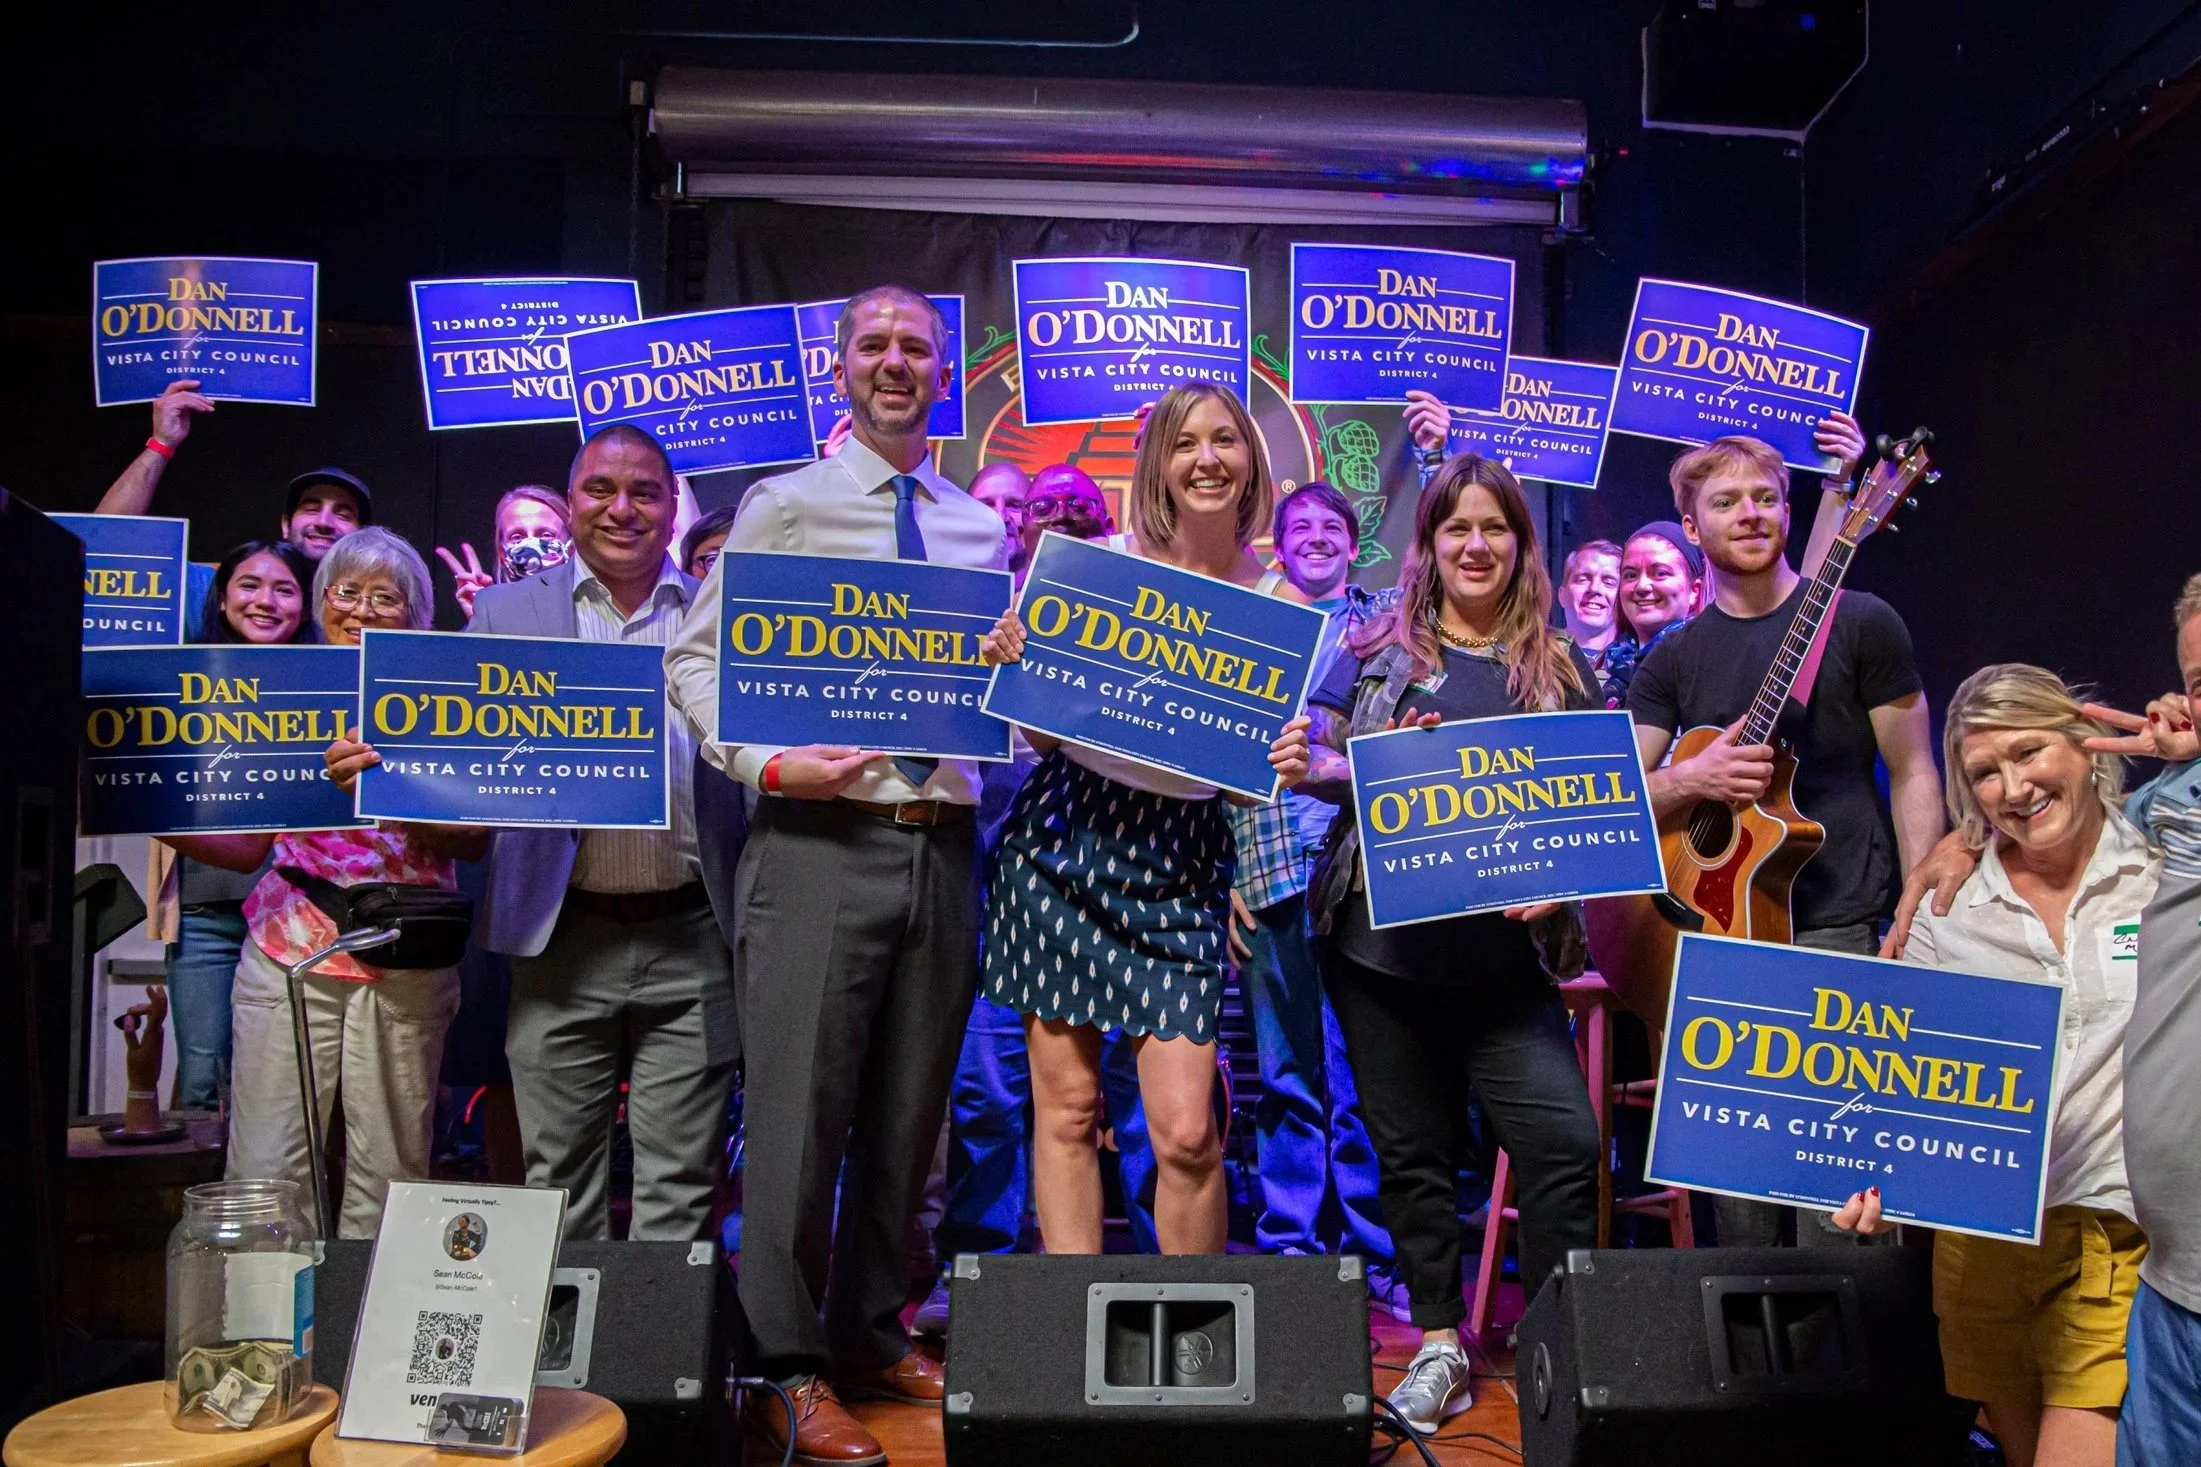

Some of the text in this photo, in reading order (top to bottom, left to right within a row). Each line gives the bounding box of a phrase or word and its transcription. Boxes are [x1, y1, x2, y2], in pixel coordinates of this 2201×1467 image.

[168, 278, 228, 301] DAN
[1105, 281, 1168, 309] DAN
[1377, 268, 1437, 298] DAN
[102, 303, 303, 336] O'DONNELL
[432, 317, 516, 330] COUNCIL
[526, 315, 567, 326] CITY
[1302, 294, 1502, 339] O'DONNELL
[1028, 310, 1240, 349] O'DONNELL
[1398, 330, 1422, 350] for
[1715, 313, 1780, 350] DAN
[107, 351, 299, 365] VISTA CITY COUNCIL
[433, 344, 568, 377] ONNELL
[648, 340, 712, 368] DAN
[1307, 350, 1496, 372] VISTA CITY COUNCIL
[1635, 330, 1845, 399] O'DONNELL
[1037, 364, 1238, 383] VISTA CITY COUNCIL
[1380, 370, 1428, 378] DISTRICT
[1507, 373, 1552, 398] DAN
[512, 375, 572, 400] DAN
[584, 360, 795, 414] O'DONNELL
[1114, 383, 1164, 392] DISTRICT
[1722, 378, 1750, 396] for
[680, 398, 704, 420] for
[1502, 398, 1600, 430] ONNELL
[1632, 381, 1822, 426] VISTA CITY COUNC
[656, 410, 797, 436] CITY COUNCIL
[1698, 412, 1748, 428] DISTRICT
[666, 438, 714, 450] DISTRICT
[1451, 429, 1592, 455] VISTA CITY COUNCIL
[832, 583, 910, 620] DAN
[1130, 586, 1211, 636] DAN
[83, 618, 166, 632] OUNCIL
[1028, 595, 1290, 704] O'DONNELL
[477, 662, 558, 697] DAN
[855, 661, 888, 684] for
[1132, 670, 1168, 688] for
[178, 673, 260, 703] DAN
[738, 681, 981, 706] VISTA CITY COUNCI
[1021, 658, 1270, 744] VISTA CITY COUNCIL
[374, 693, 654, 738] O'DONNELL
[832, 710, 908, 720] DISTRICT 4
[1101, 707, 1175, 735] DISTRICT 4
[208, 744, 241, 768] for
[502, 738, 536, 762] for
[1456, 746, 1535, 778] DAN
[95, 768, 330, 785] VISTA CITY COUNC
[383, 762, 649, 778] VISTA CITY COUNCIL
[186, 792, 264, 802] DISTRICT 4
[478, 786, 556, 795] DISTRICT 4
[1370, 772, 1636, 834] O'DONNELL
[1495, 814, 1526, 840] for
[1384, 830, 1640, 873] VISTA CITY COUNCIL
[1478, 860, 1554, 878] DISTRICT 4
[1809, 988, 1914, 1042] DAN
[1682, 1016, 2034, 1114] O'DONNELL
[1830, 1092, 1874, 1120] for
[1682, 1102, 2020, 1168] VISTA CITY COUNCIL
[1796, 1151, 1893, 1174] DISTRICT 4
[434, 1269, 452, 1278] Sean
[410, 1394, 438, 1407] ven
